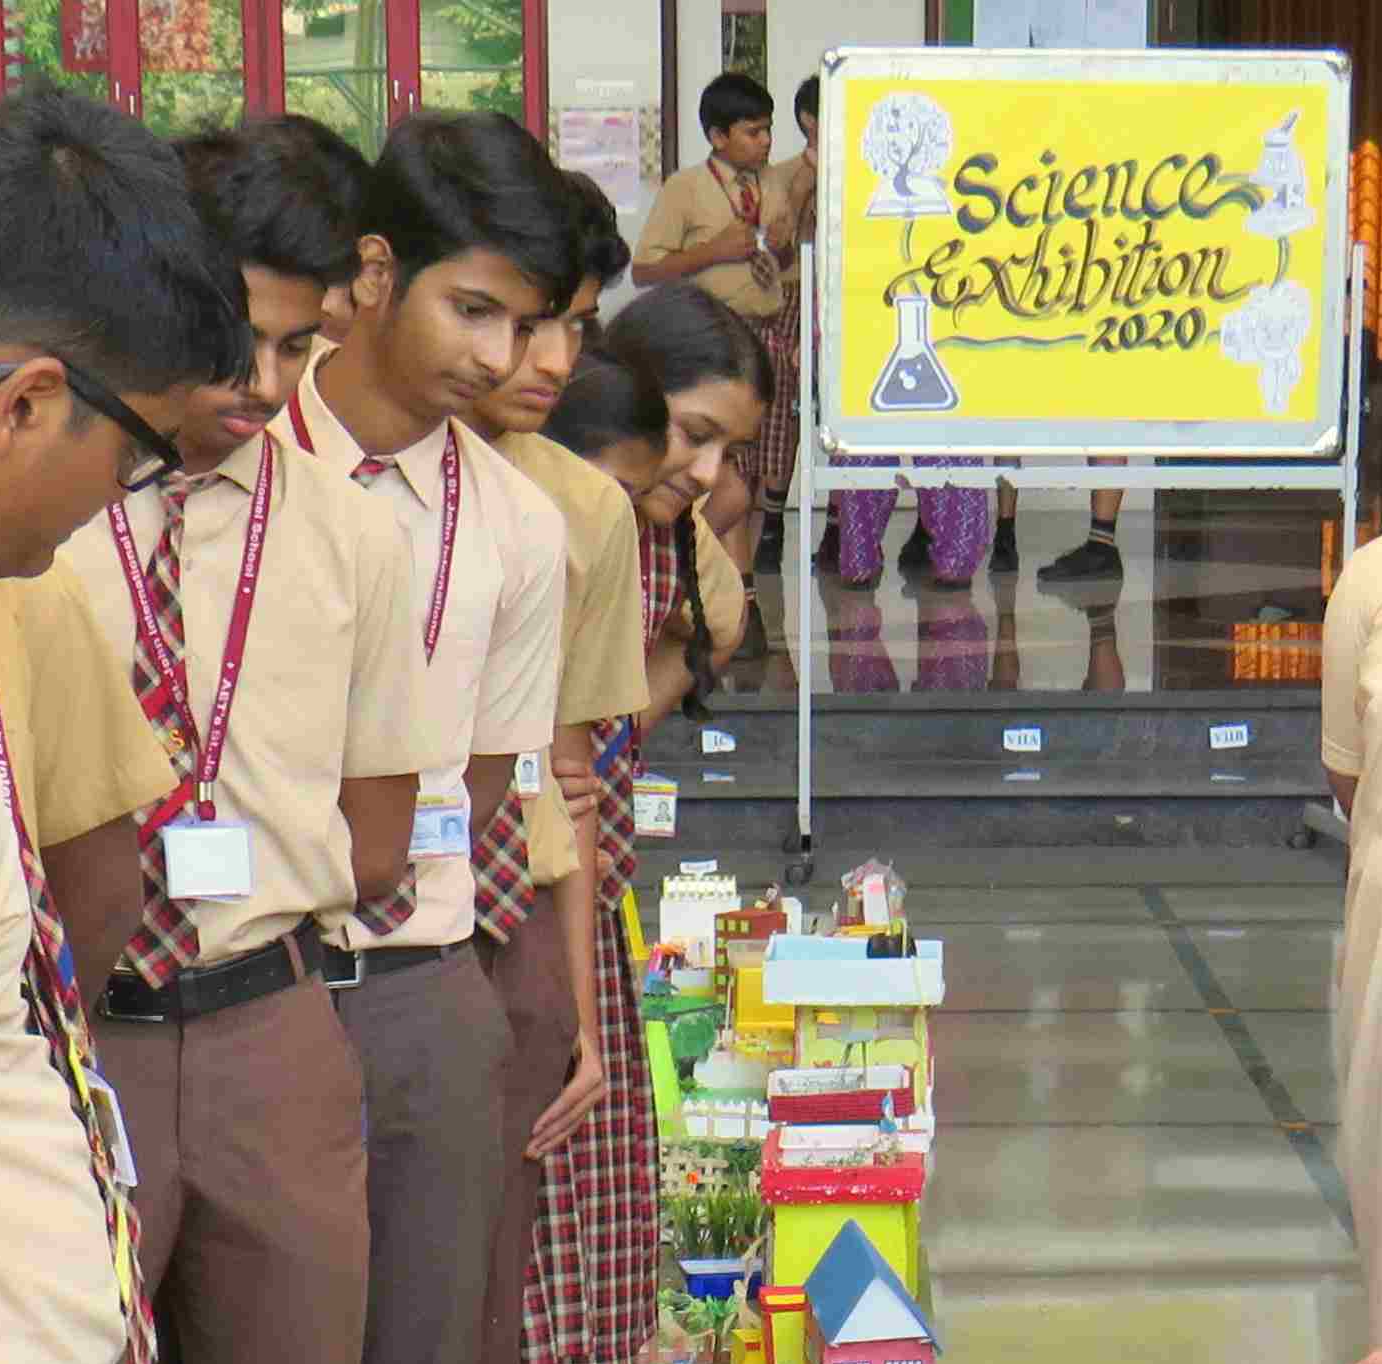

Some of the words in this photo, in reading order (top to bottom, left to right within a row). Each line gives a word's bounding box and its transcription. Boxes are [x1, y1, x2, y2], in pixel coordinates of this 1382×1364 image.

[953, 150, 1265, 234] Science
[884, 218, 1263, 328] Exhibition
[1089, 304, 1207, 353] 2020
[244, 522, 263, 578] School
[119, 535, 158, 636] International
[153, 638, 174, 678] John
[213, 677, 233, 726] AET's
